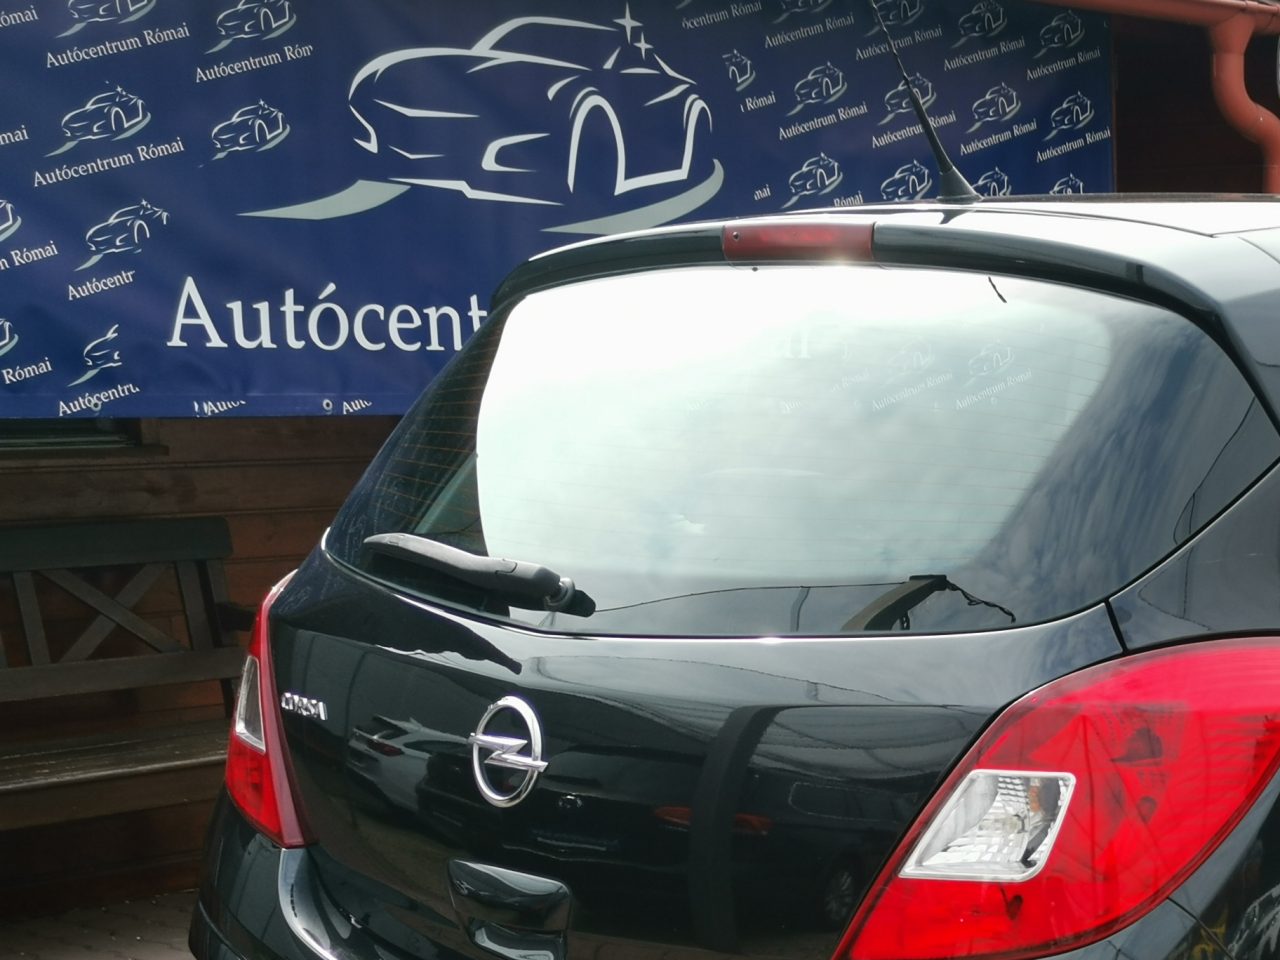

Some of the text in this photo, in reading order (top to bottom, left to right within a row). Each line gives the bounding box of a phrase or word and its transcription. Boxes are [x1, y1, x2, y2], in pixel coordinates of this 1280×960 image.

[47, 22, 190, 68] Autócentrum Római
[764, 12, 855, 49] Autócentrum Római
[195, 51, 282, 83] Autócentrum
[943, 36, 1026, 72] Autócentrum Római
[1026, 58, 1076, 81] Autócentrum
[745, 91, 776, 111] Római
[778, 101, 869, 141] Autócentrum Római
[960, 118, 1038, 156] Autócentrum Római
[33, 136, 185, 187] Autócentrum Római
[1036, 126, 1111, 163] Autócentrum Római
[10, 240, 58, 266] Római
[2, 356, 52, 384] Római
